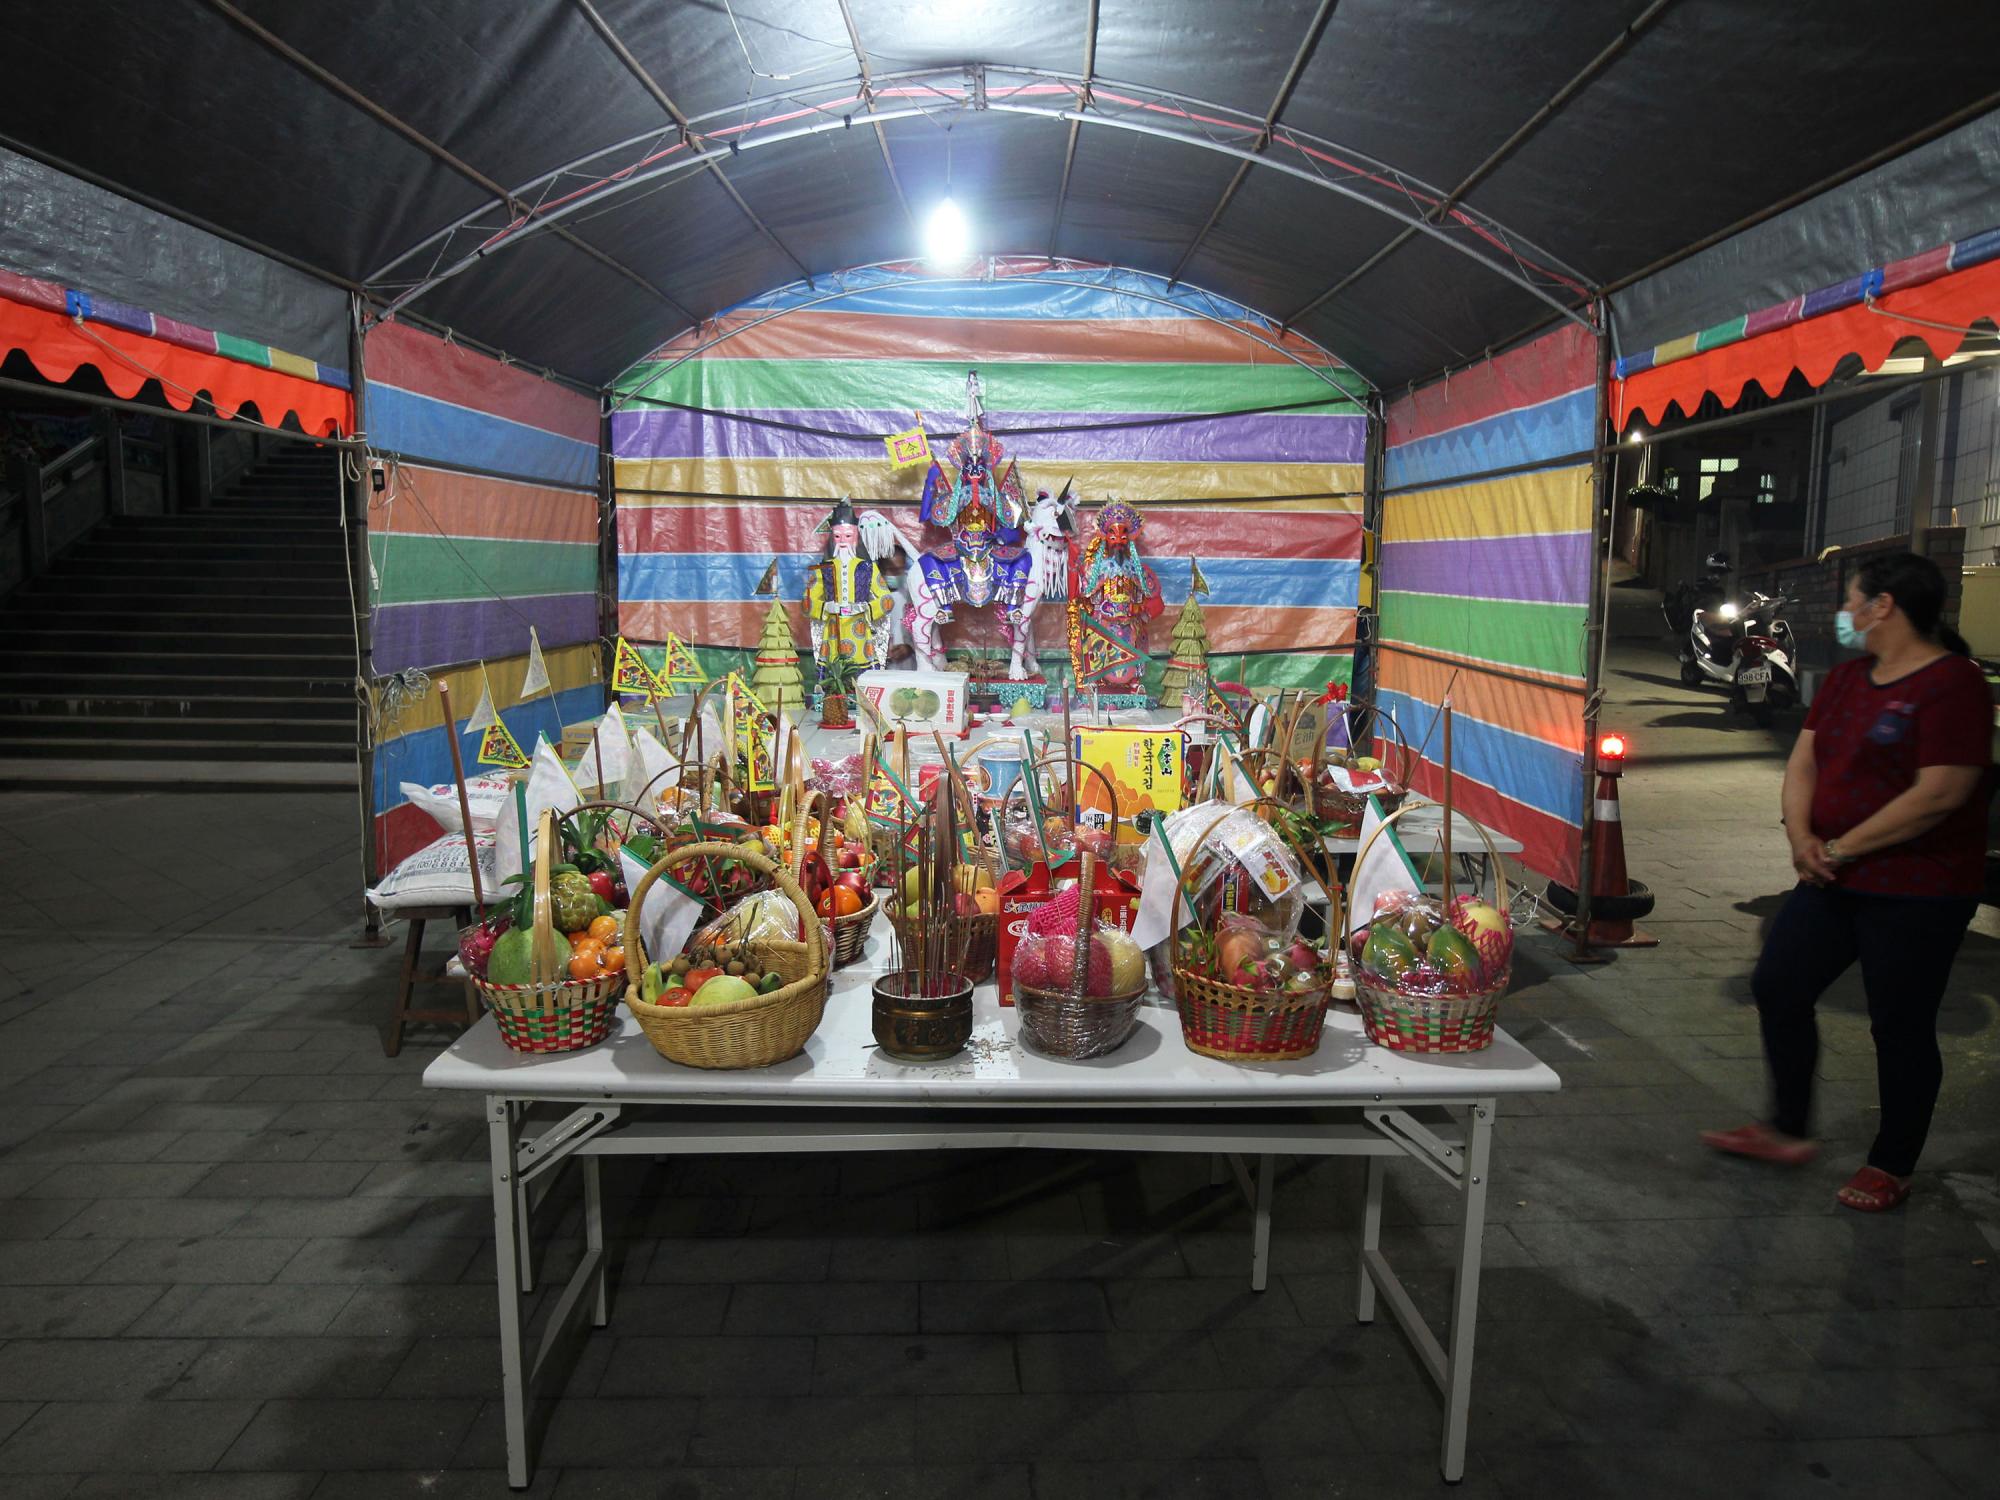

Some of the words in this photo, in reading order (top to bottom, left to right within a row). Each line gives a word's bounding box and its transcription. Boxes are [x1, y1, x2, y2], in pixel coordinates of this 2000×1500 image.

[1142, 738, 1155, 790] 한국식김
[1161, 738, 1173, 776] 元本山
